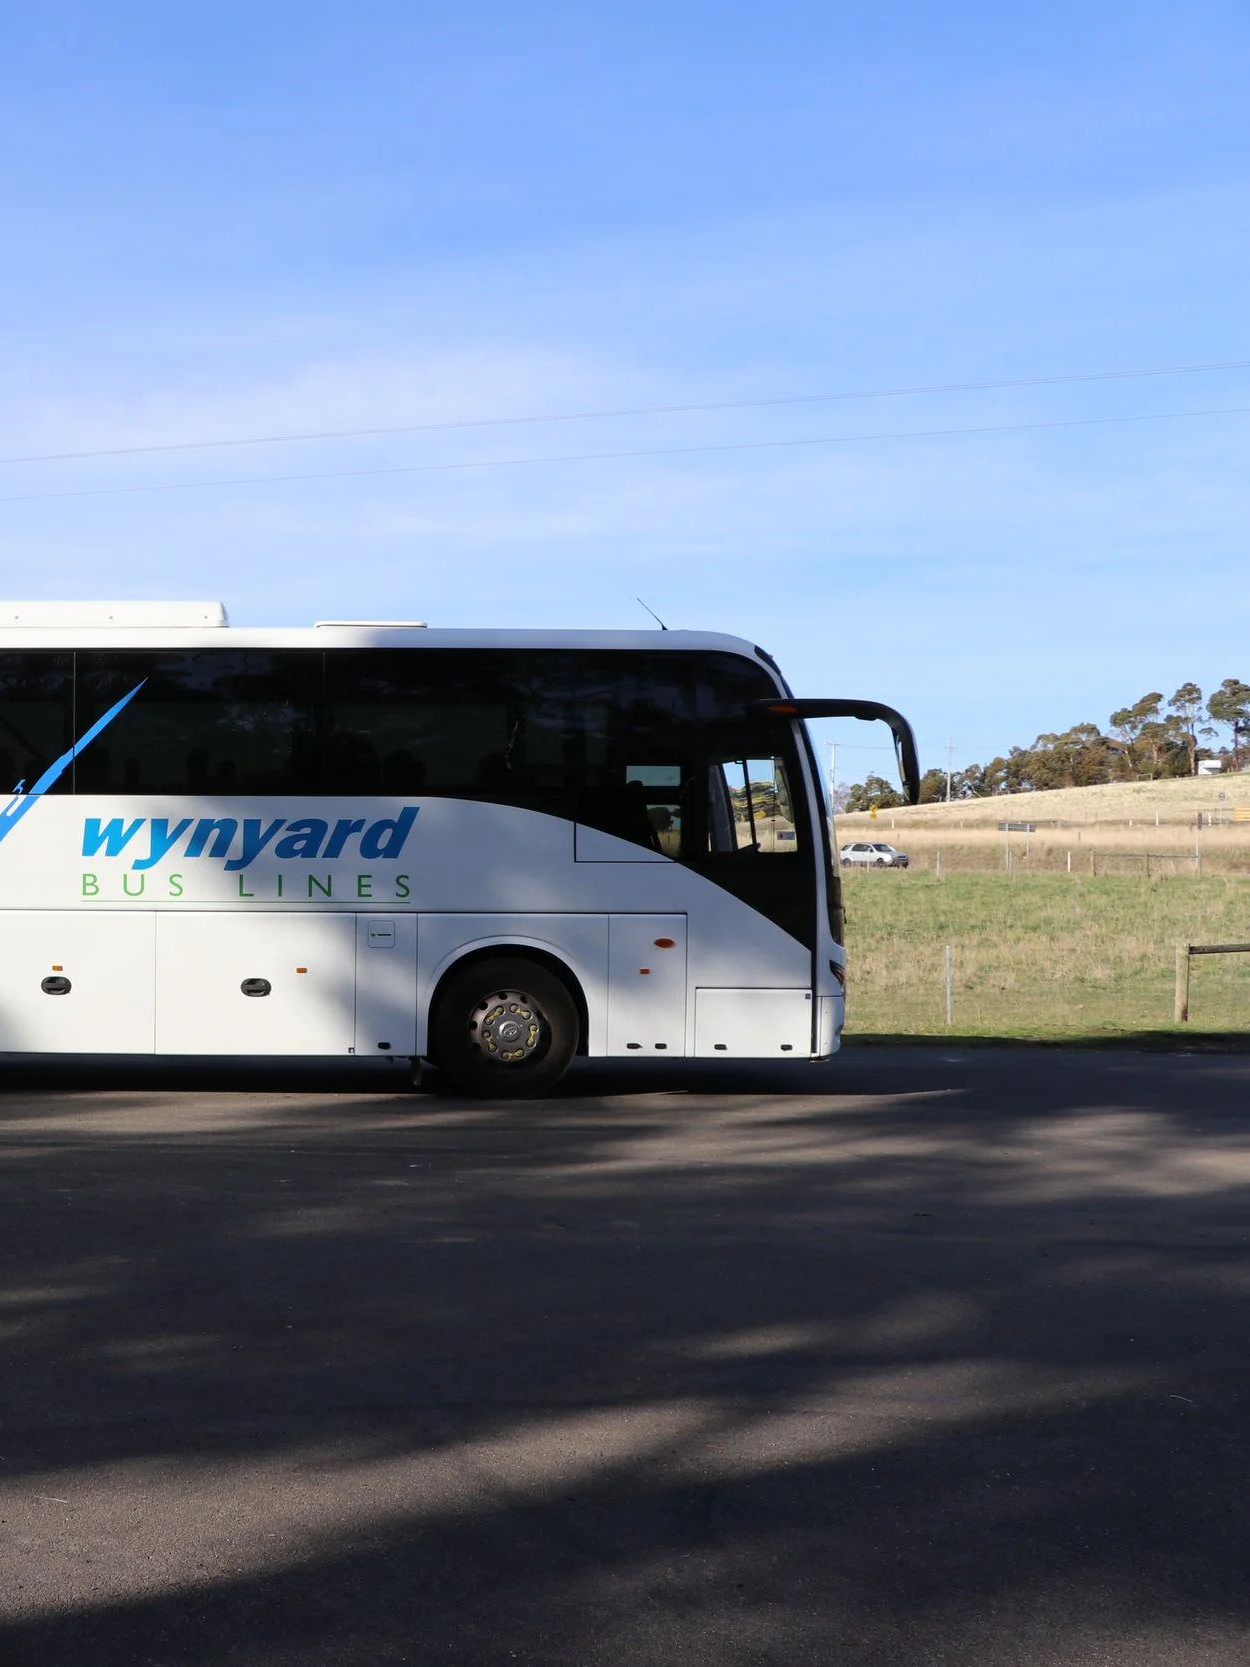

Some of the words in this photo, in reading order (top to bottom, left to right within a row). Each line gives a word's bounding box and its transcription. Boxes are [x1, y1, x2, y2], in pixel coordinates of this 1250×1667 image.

[81, 806, 420, 871] wynyard
[82, 873, 184, 897] BUS
[238, 874, 411, 898] LINES
